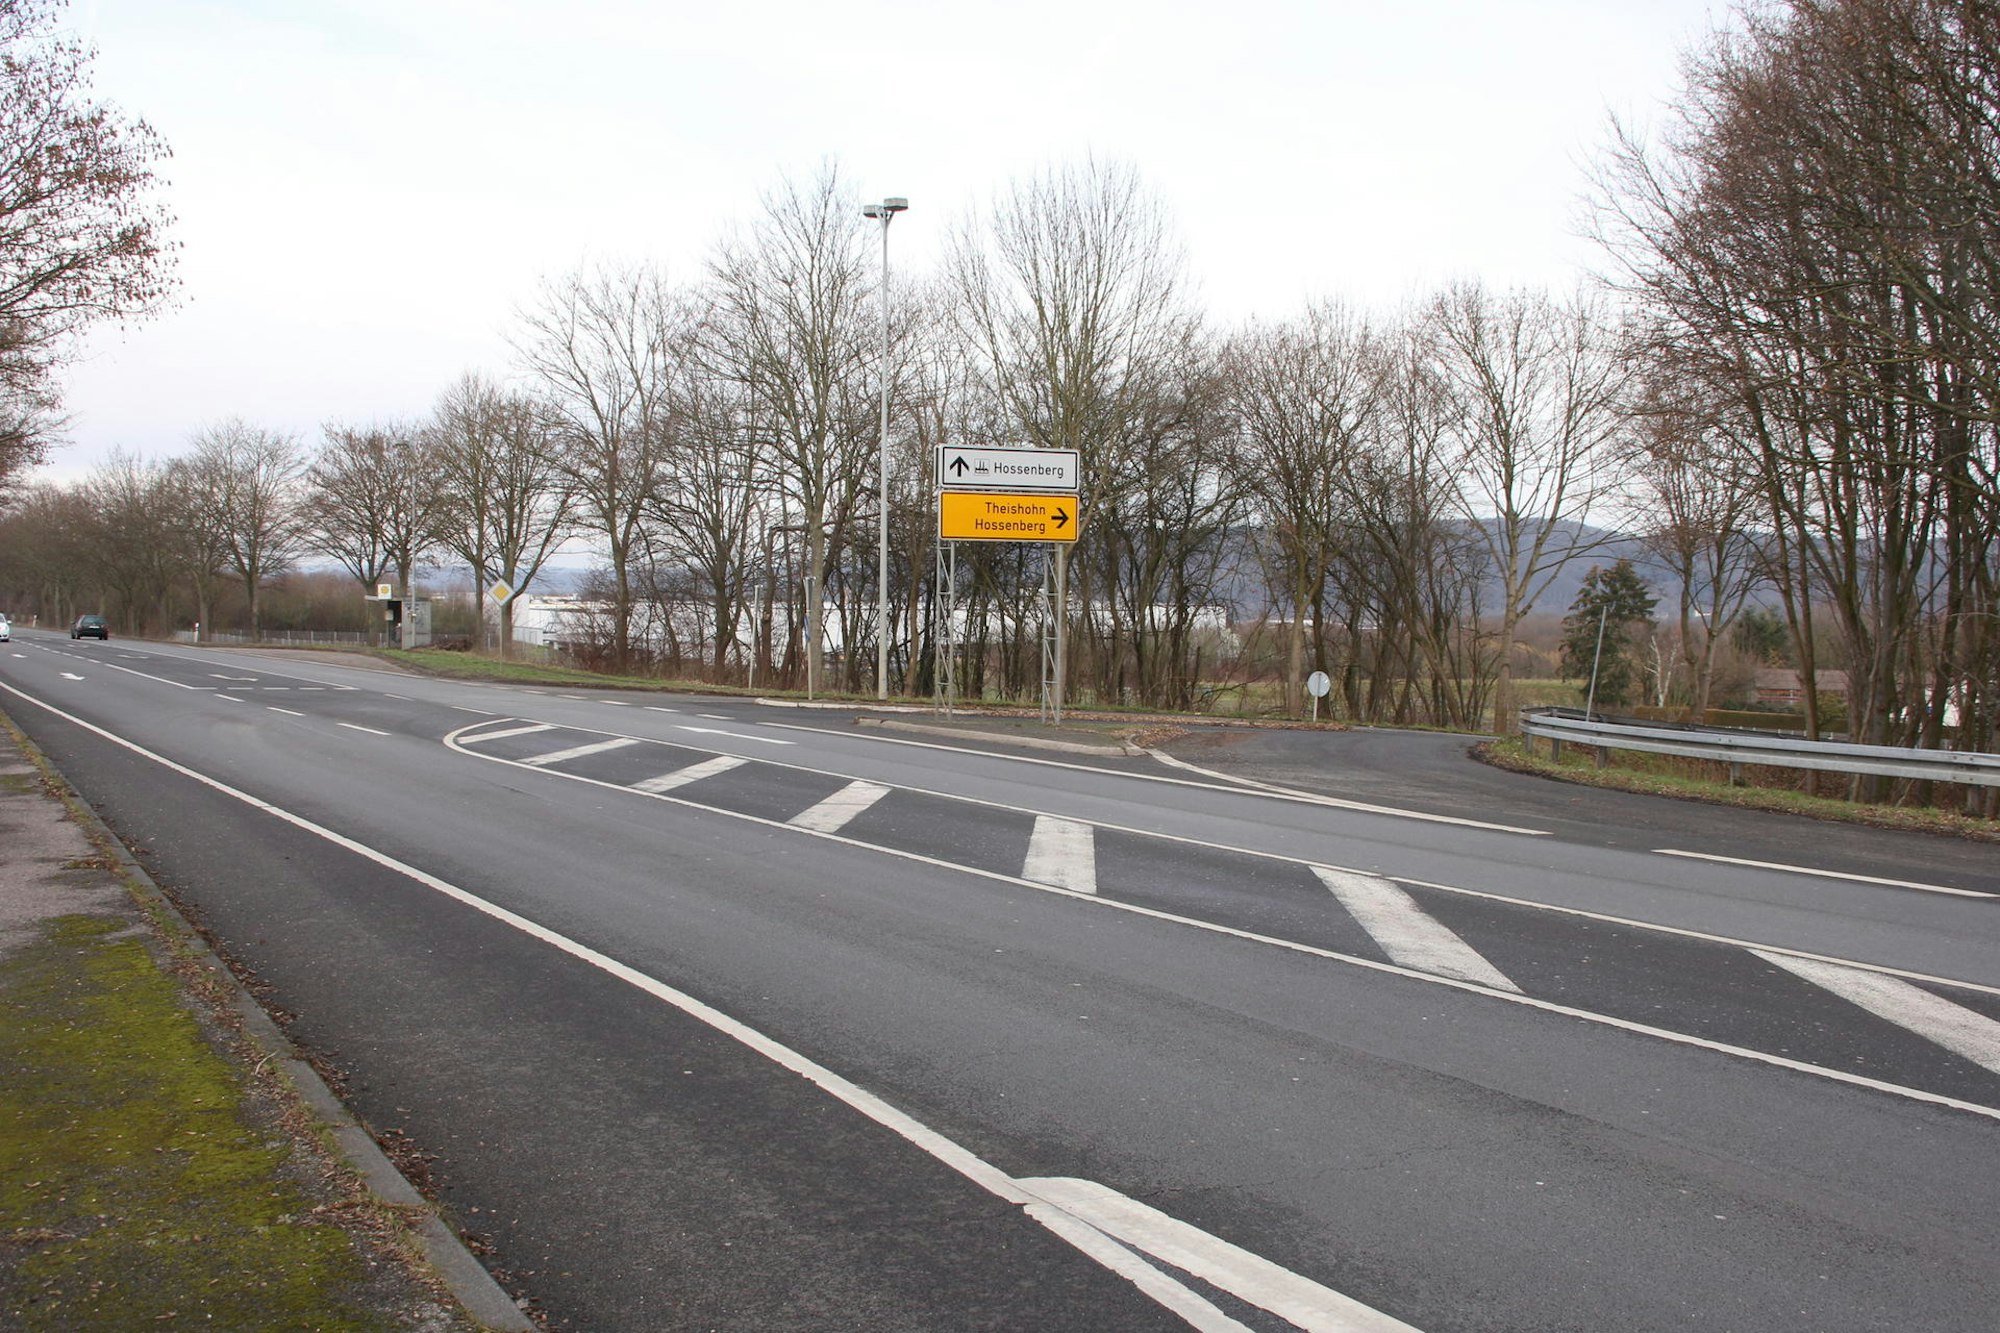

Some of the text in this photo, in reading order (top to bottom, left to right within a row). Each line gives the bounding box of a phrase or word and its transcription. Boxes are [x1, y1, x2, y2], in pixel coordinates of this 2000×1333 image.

[994, 462, 1064, 478] Hossenberg
[985, 502, 1046, 515] Theishohn
[975, 518, 1046, 534] Hossenberg
